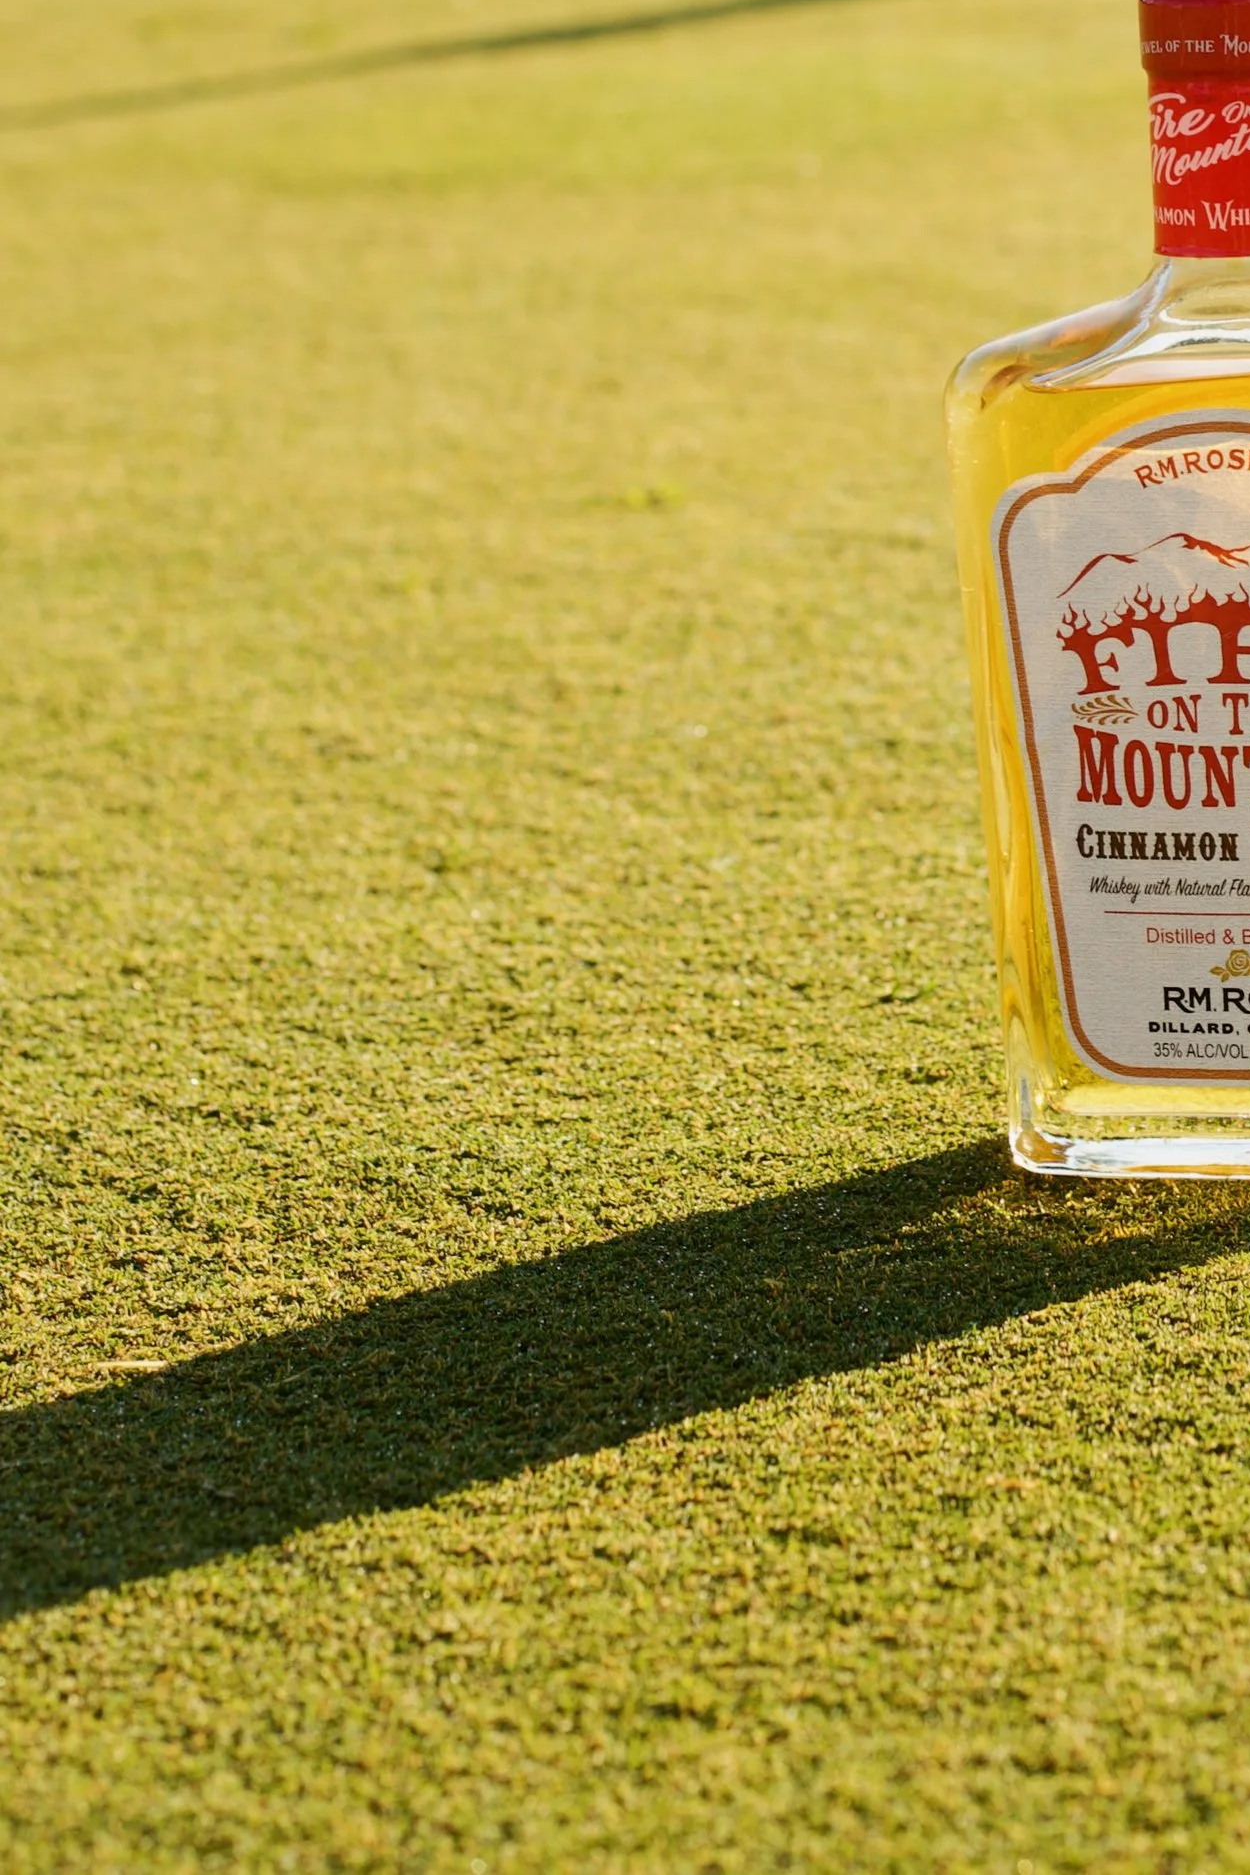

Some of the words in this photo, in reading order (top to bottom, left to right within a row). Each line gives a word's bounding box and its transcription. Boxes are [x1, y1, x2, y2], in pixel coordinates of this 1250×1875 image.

[1165, 39, 1181, 53] OF
[1184, 39, 1215, 53] THE
[1146, 694, 1202, 734] ON
[1075, 823, 1240, 862] CINNAMON
[1089, 876, 1141, 904] Whiskey
[1144, 877, 1171, 897] with
[1174, 878, 1227, 898] Natural
[1146, 927, 1216, 945] Distilled
[1222, 929, 1235, 945] &
[1148, 1021, 1240, 1036] DILLARD,
[1153, 1042, 1183, 1058] 35%
[1186, 1043, 1249, 1059] ALC/VOL
